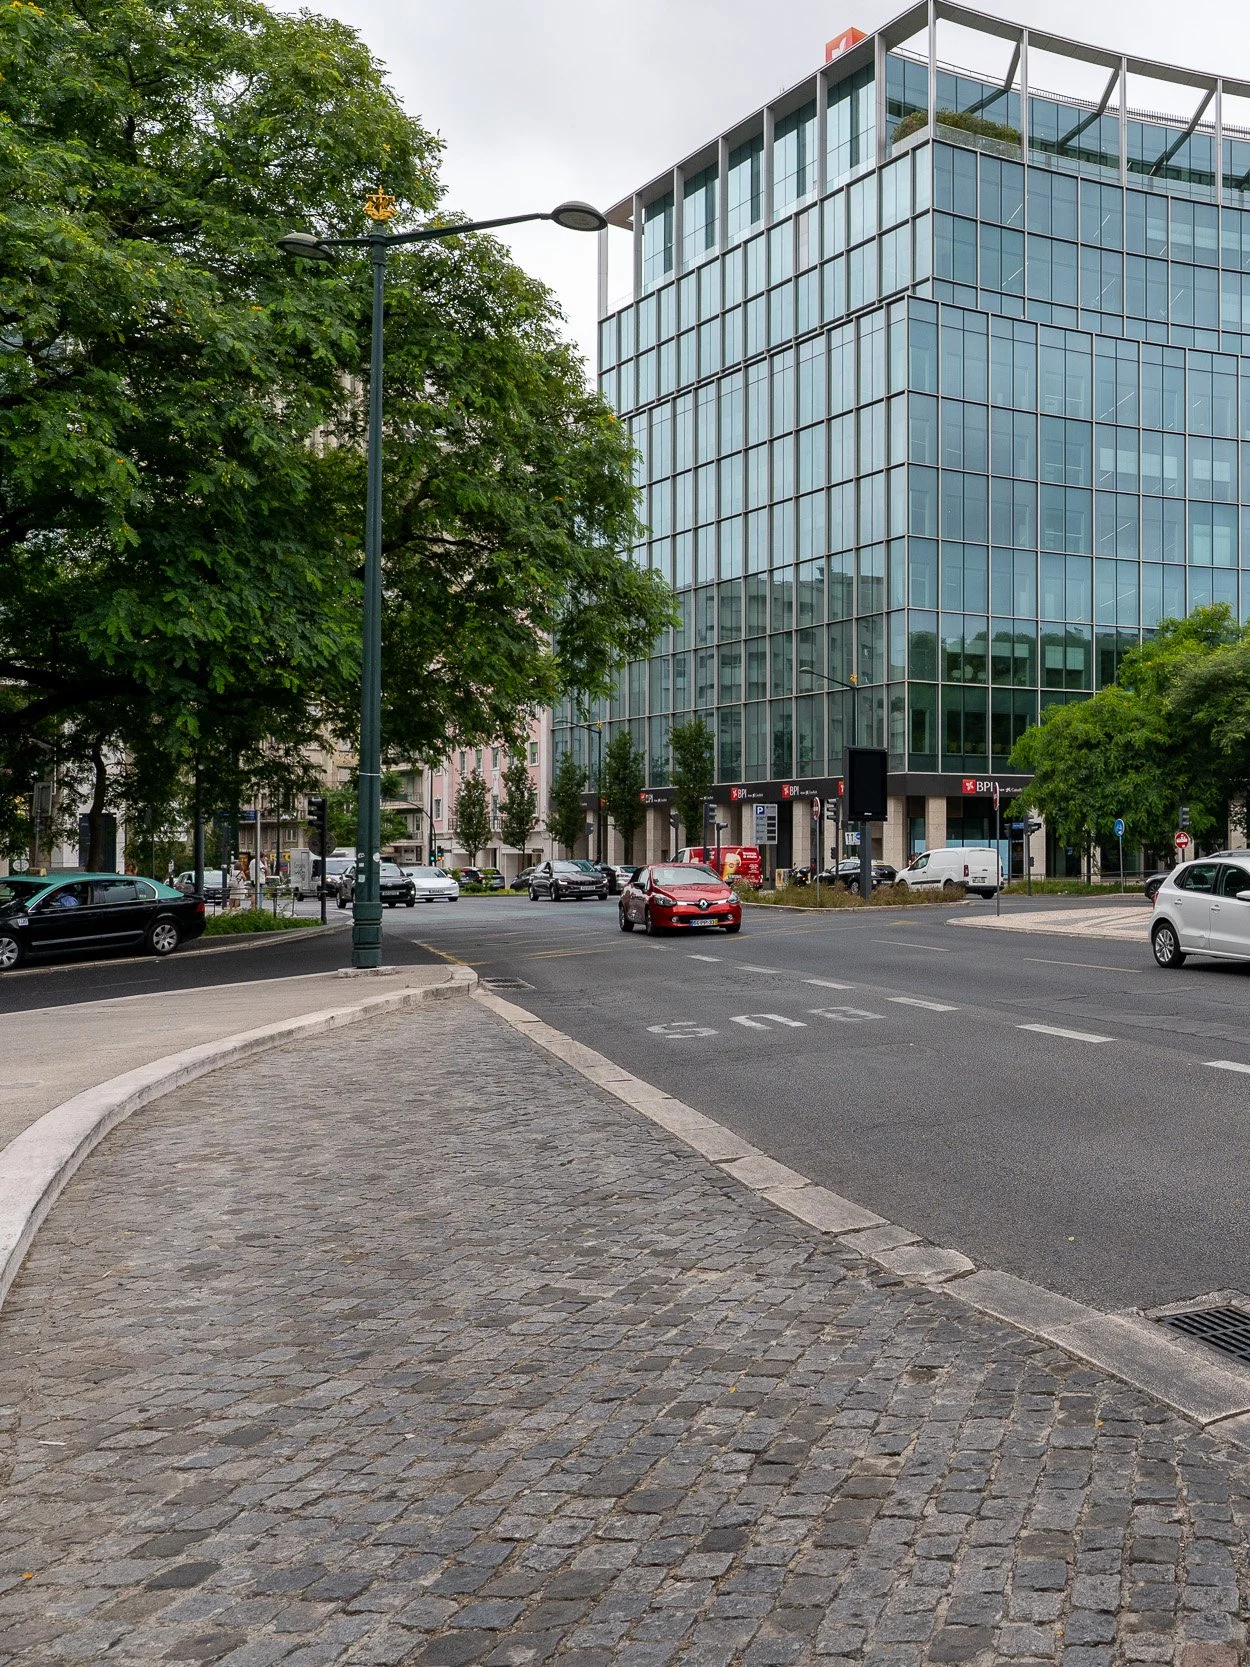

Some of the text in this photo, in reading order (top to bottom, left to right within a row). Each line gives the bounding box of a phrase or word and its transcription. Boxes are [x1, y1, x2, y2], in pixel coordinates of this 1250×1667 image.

[789, 785, 800, 796] BPI
[976, 781, 993, 792] BPI
[737, 788, 747, 799] BPI
[757, 806, 764, 814] P
[646, 1006, 888, 1039] BUS
